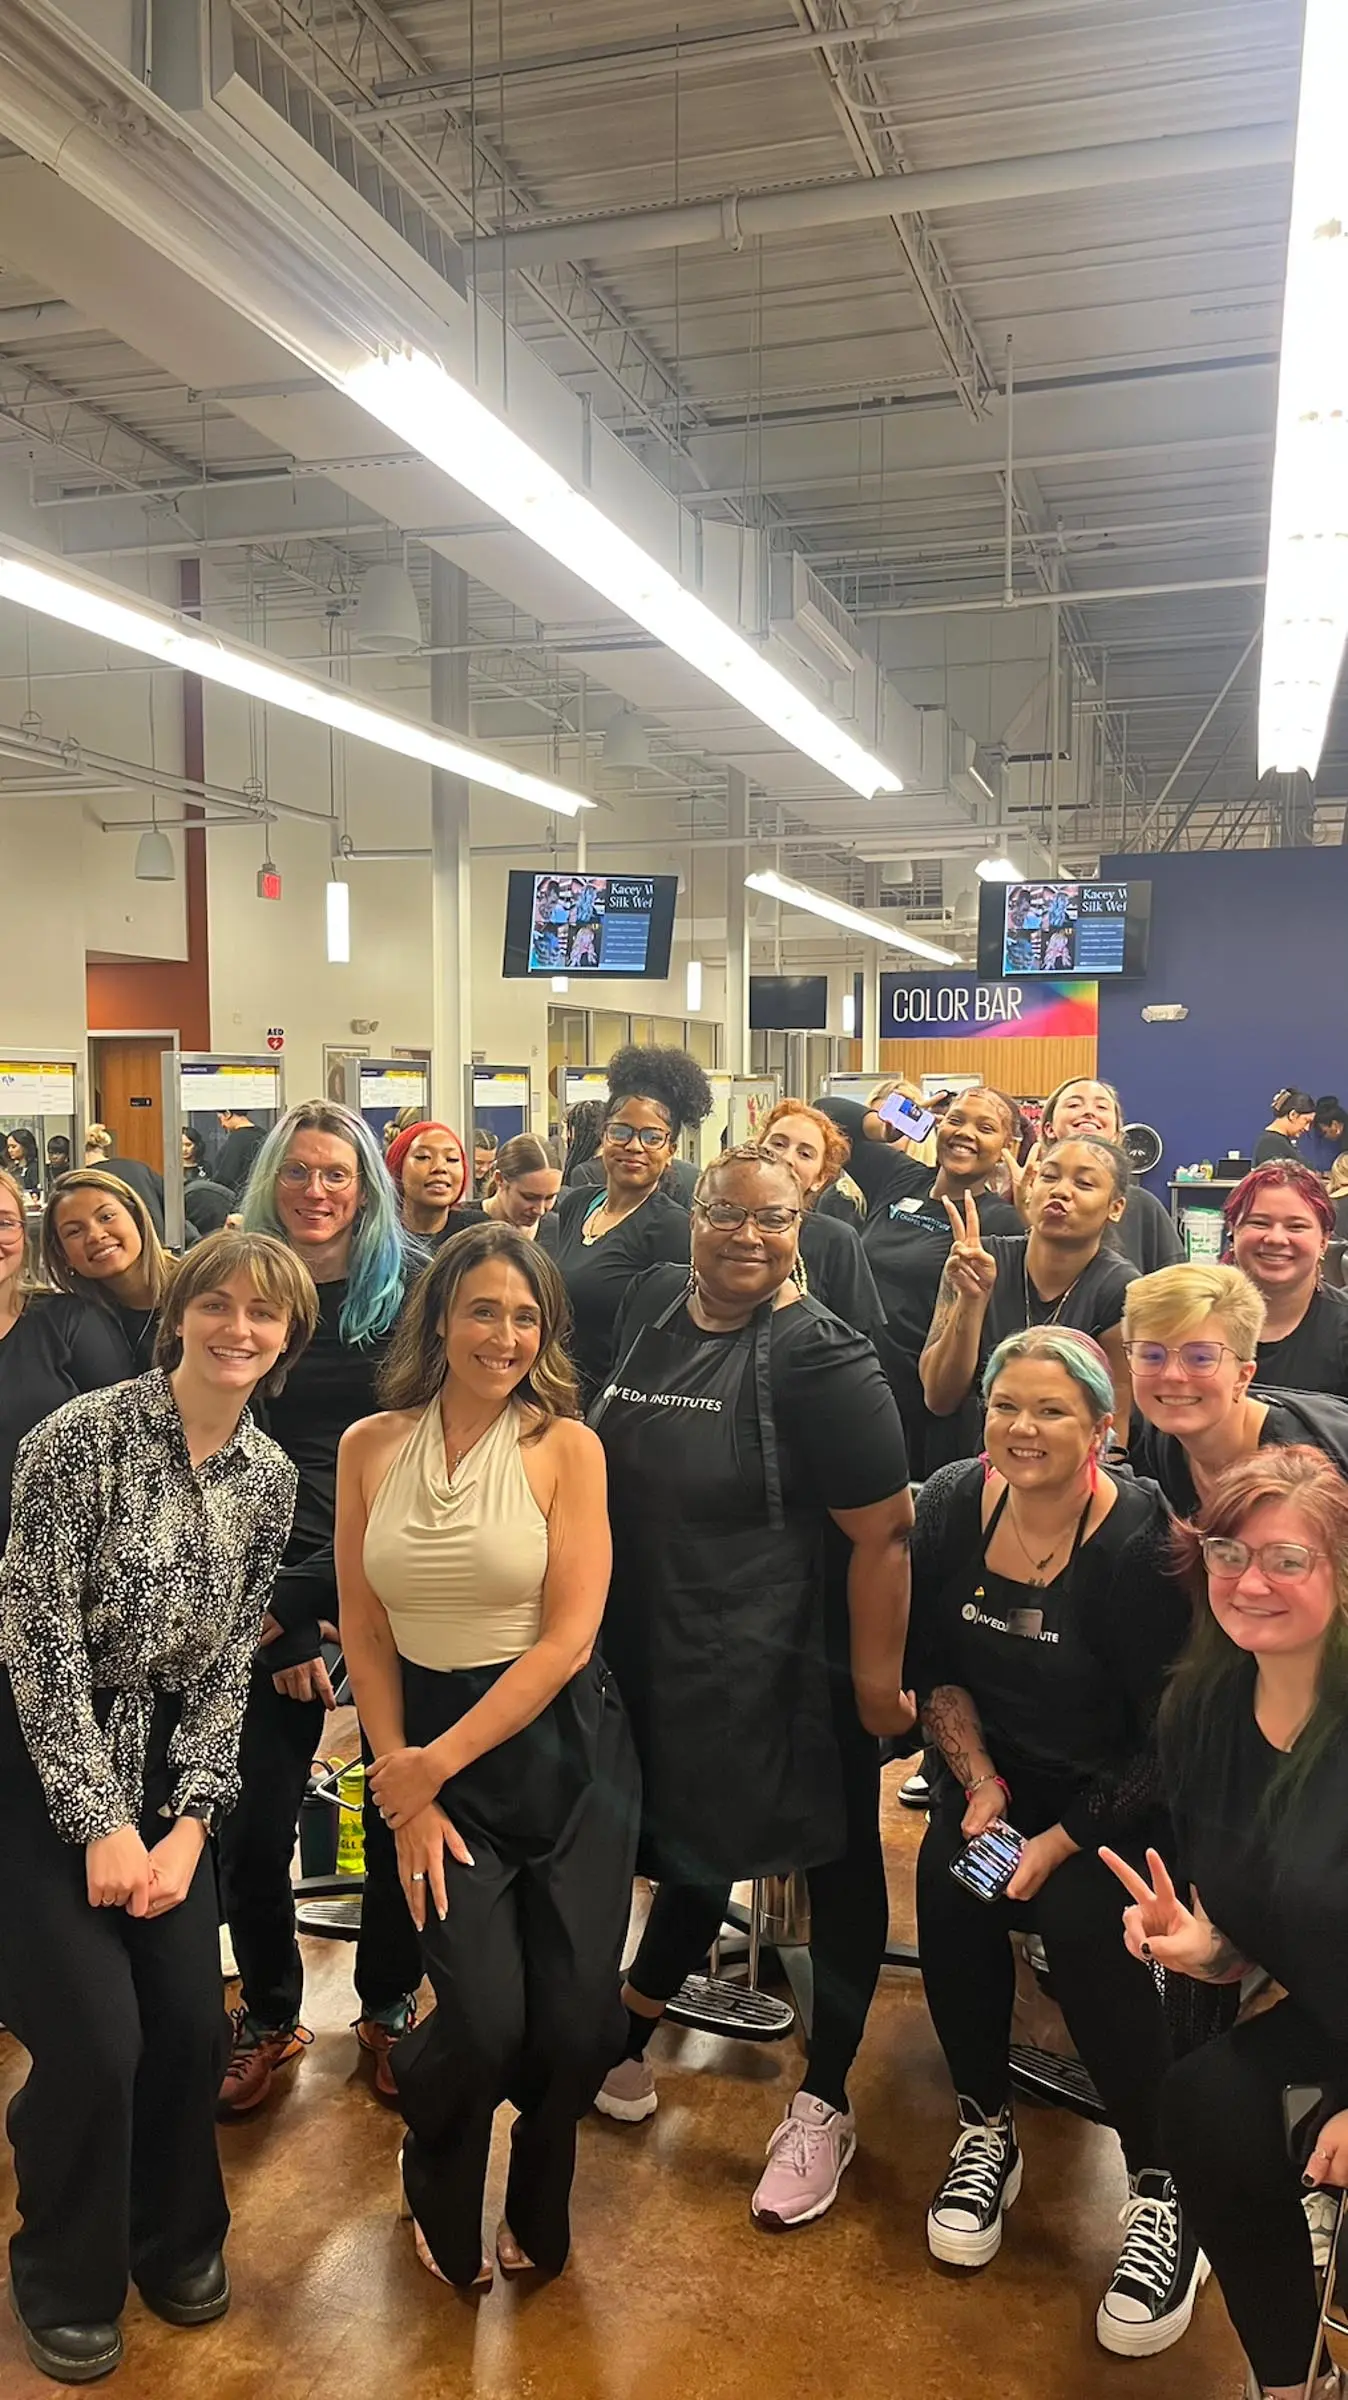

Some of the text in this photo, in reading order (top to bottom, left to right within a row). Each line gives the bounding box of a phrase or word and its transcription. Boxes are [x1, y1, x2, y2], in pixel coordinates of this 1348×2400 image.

[611, 883, 642, 897] Kacey
[1083, 888, 1115, 900] Kacey
[609, 895, 630, 908] Silk
[1082, 901, 1103, 912] Silk
[892, 986, 1022, 1022] COLOR BAR
[267, 1028, 284, 1036] AED
[649, 1393, 724, 1412] INSTITUTES
